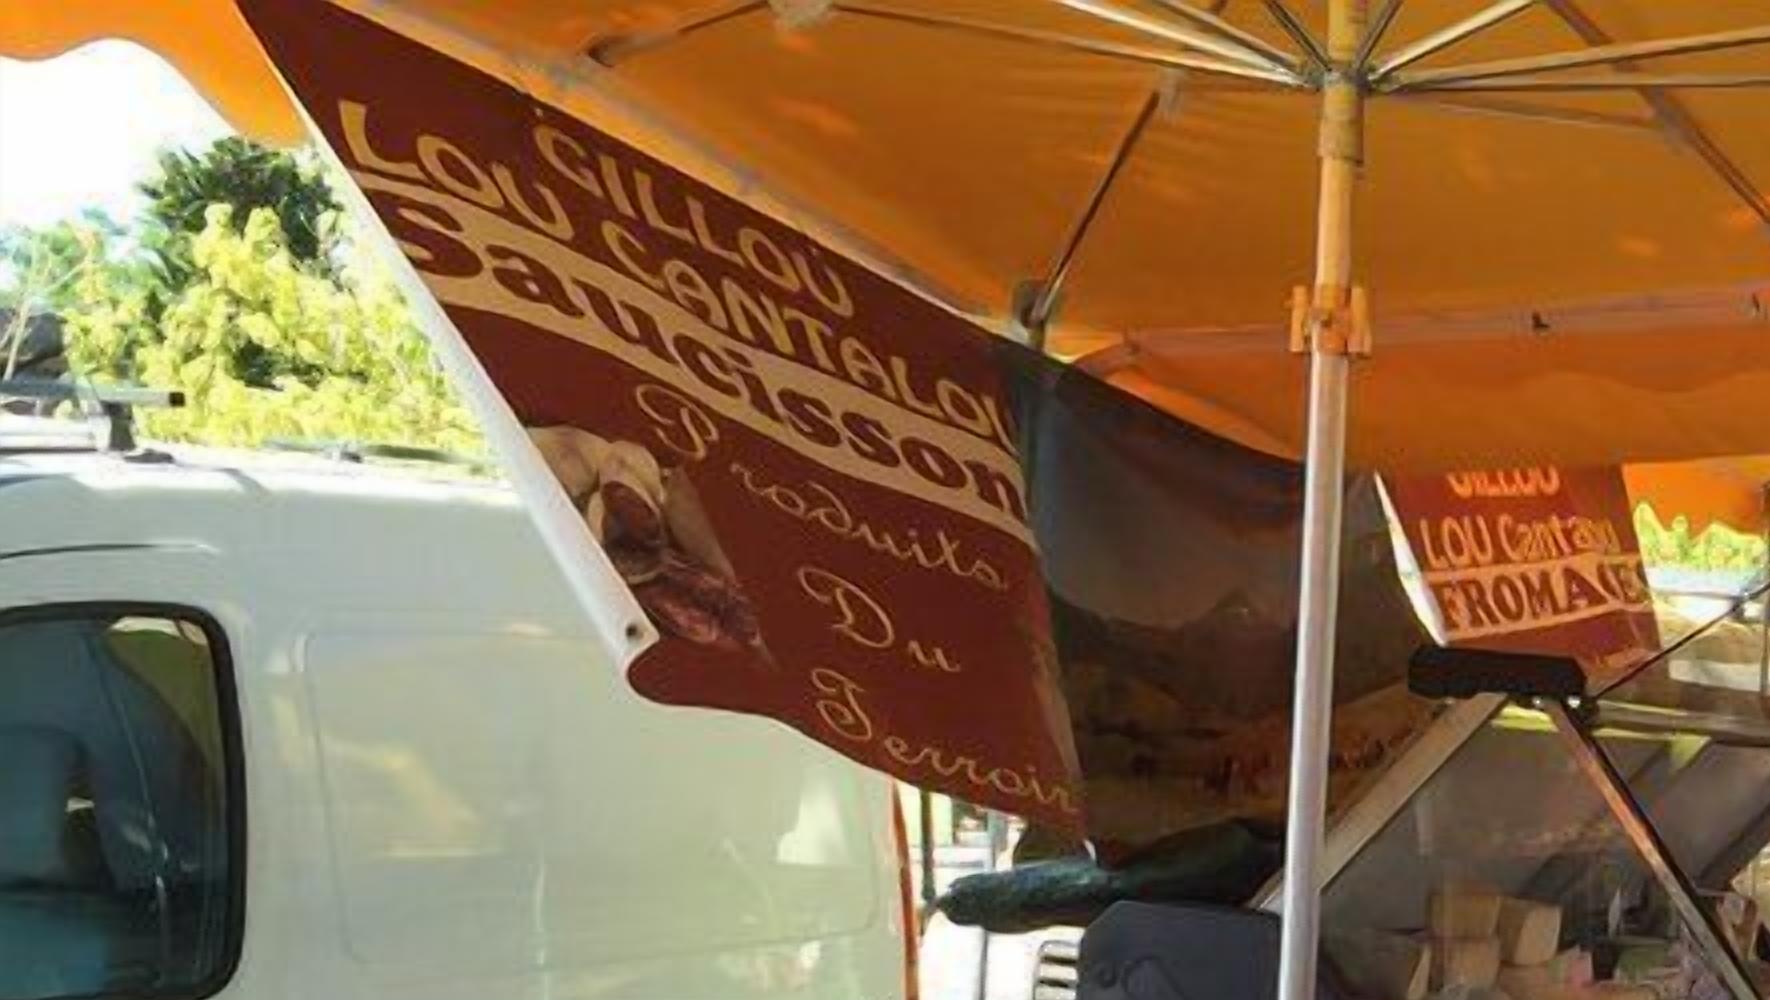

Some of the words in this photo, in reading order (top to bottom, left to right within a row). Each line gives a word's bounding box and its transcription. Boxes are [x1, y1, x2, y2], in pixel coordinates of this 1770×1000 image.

[339, 100, 572, 242] LOU
[533, 124, 854, 319] GILLOU
[372, 194, 1026, 521] Saucisson
[636, 384, 1007, 591] Produits
[1420, 515, 1493, 570] LOU
[799, 566, 961, 673] Du
[810, 667, 1081, 812] Terroir
